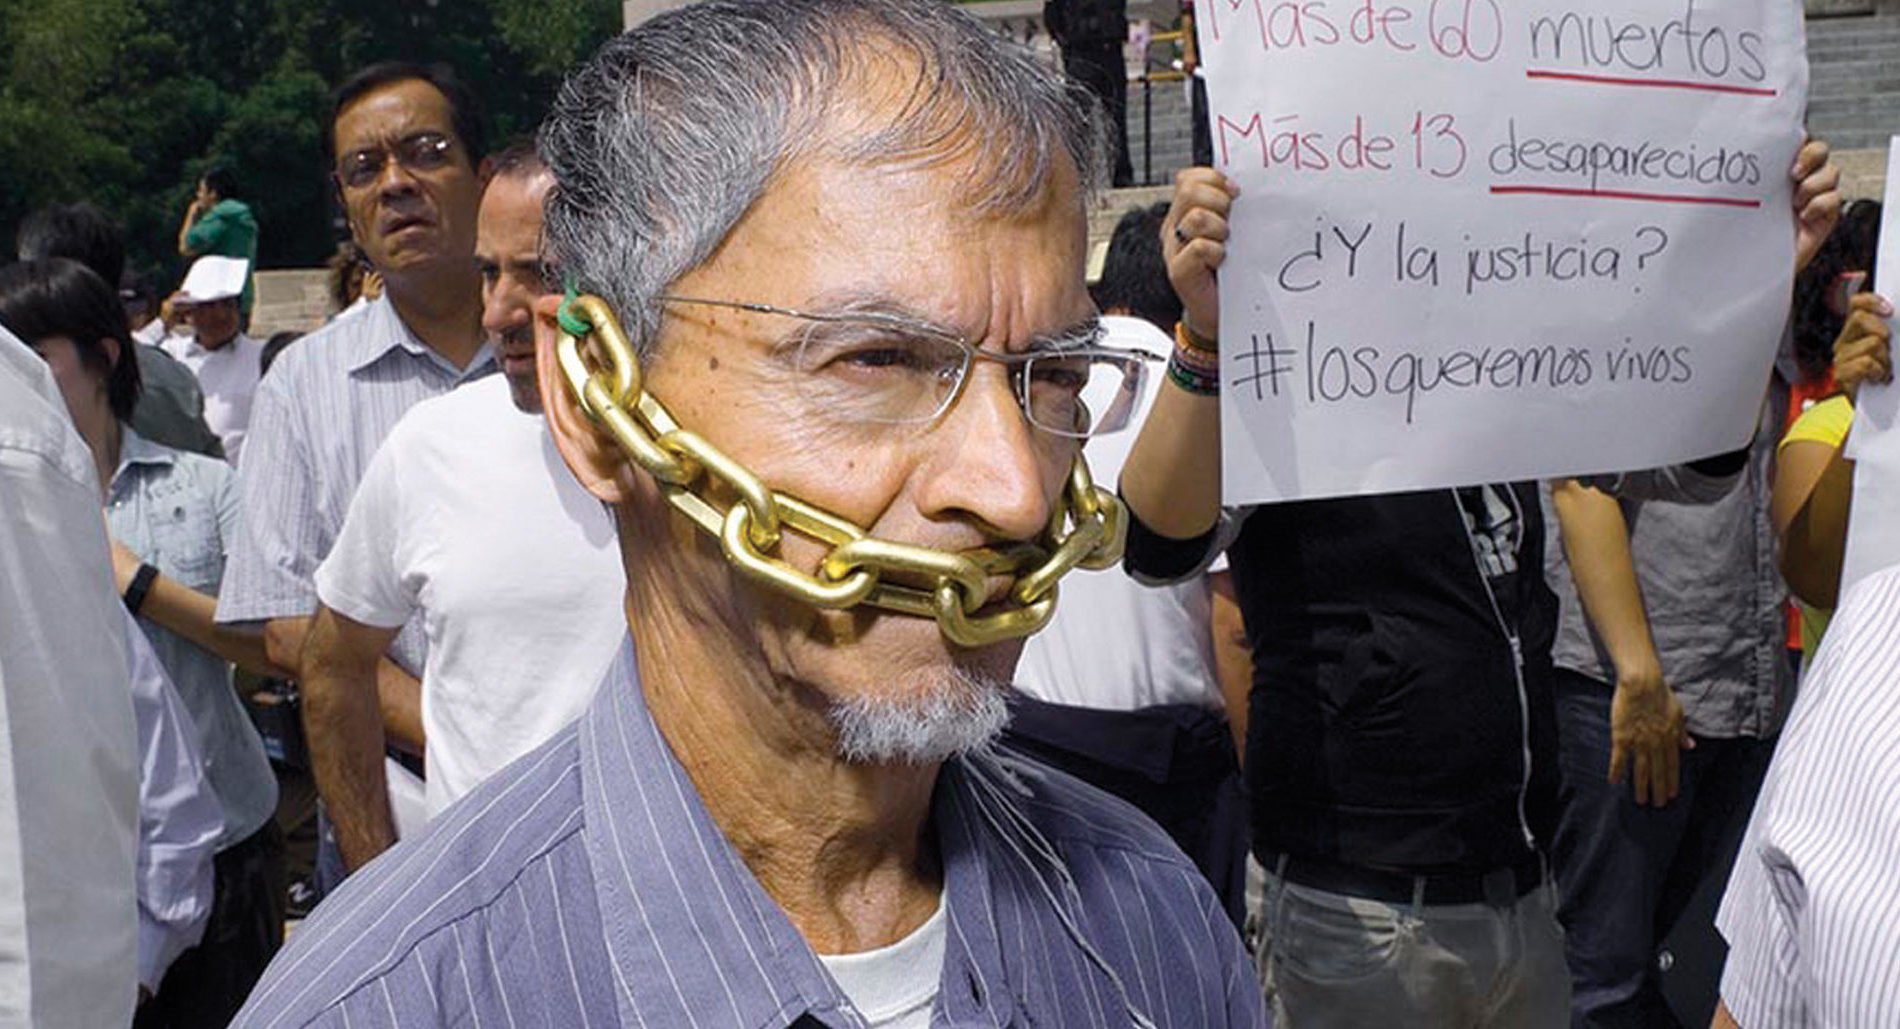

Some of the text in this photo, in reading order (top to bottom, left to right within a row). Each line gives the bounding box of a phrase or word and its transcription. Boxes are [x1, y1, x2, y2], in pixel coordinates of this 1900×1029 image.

[1350, 0, 1416, 50] de
[1430, 0, 1502, 62] 60
[1530, 0, 1766, 82] muertos
[1218, 110, 1761, 193] Más de 13 desaparecidos
[1278, 215, 1372, 292] ¿Y
[1396, 221, 1438, 286] la
